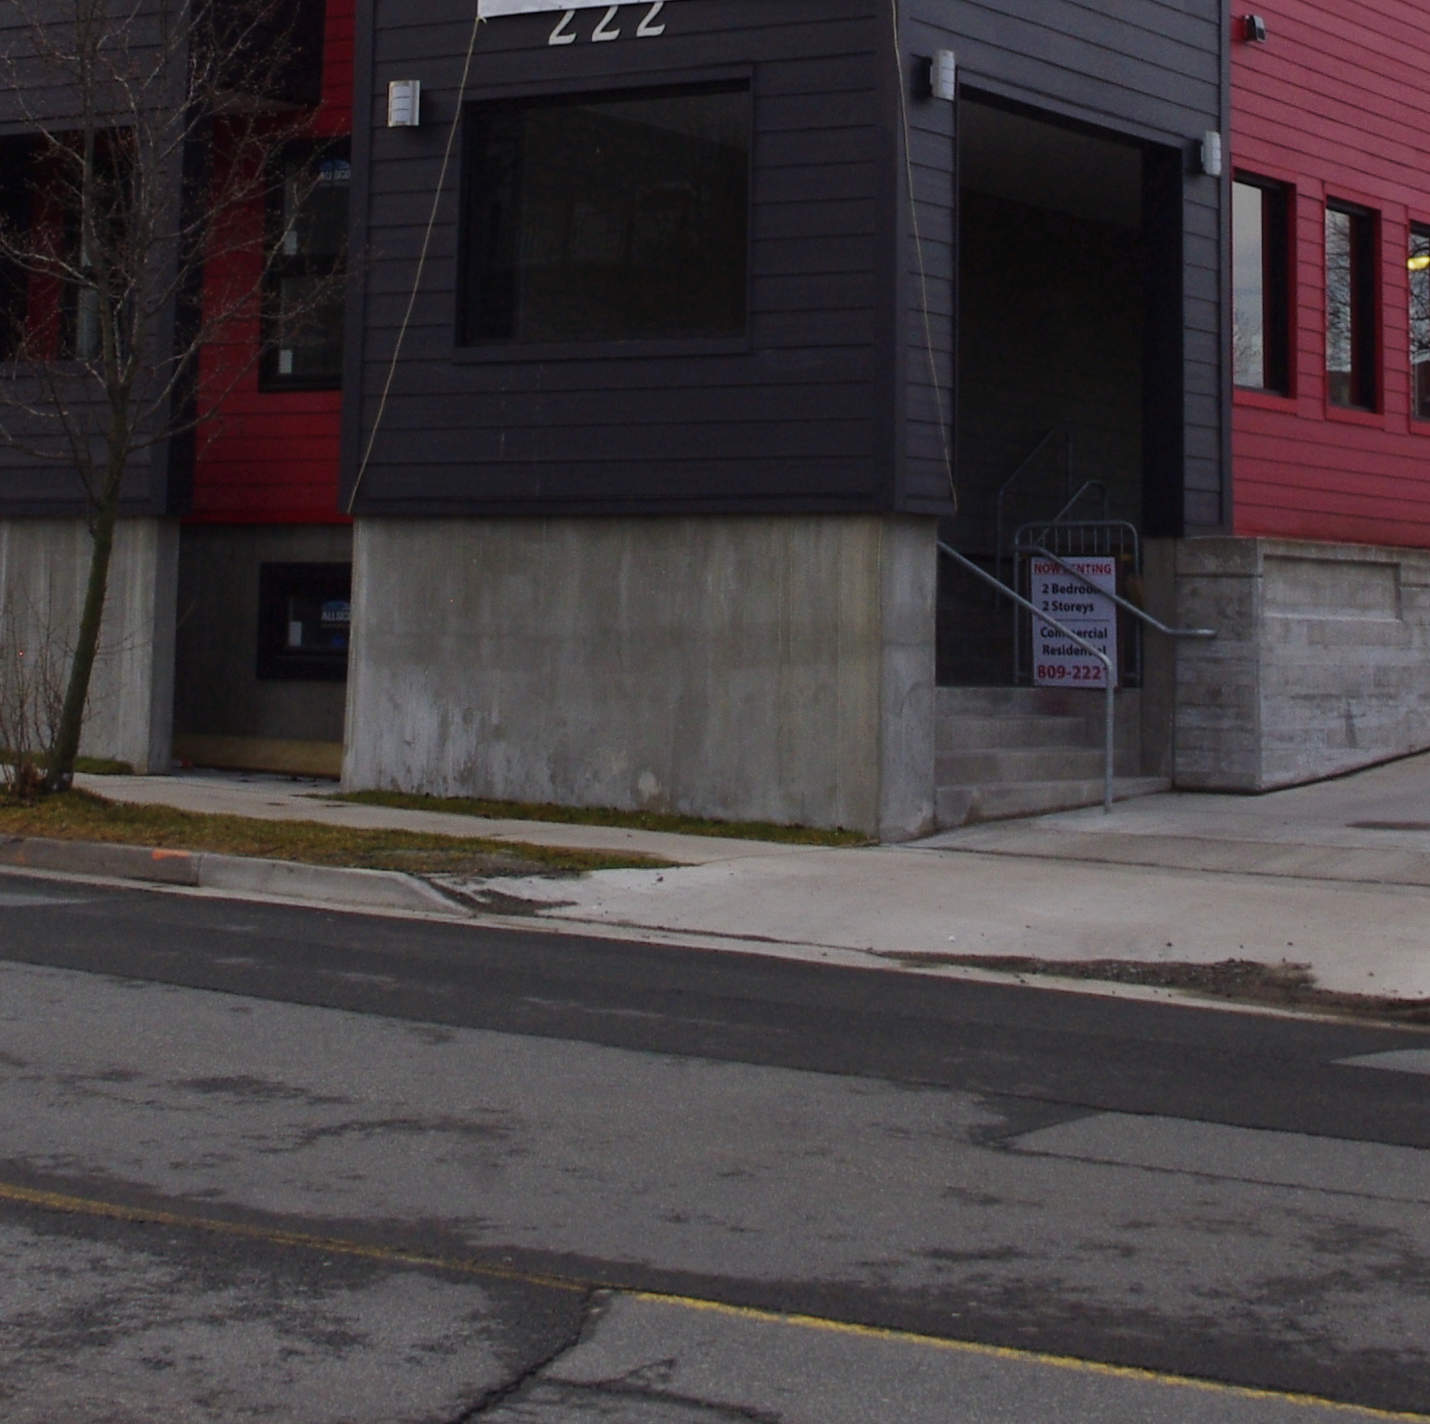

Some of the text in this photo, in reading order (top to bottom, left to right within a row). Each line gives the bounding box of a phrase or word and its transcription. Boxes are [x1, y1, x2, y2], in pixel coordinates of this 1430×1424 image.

[1035, 563, 1061, 574] NOW
[1042, 582, 1103, 594] 2 Bedroo
[1042, 600, 1094, 614] 2 Storeys
[1040, 627, 1107, 639] Comercial
